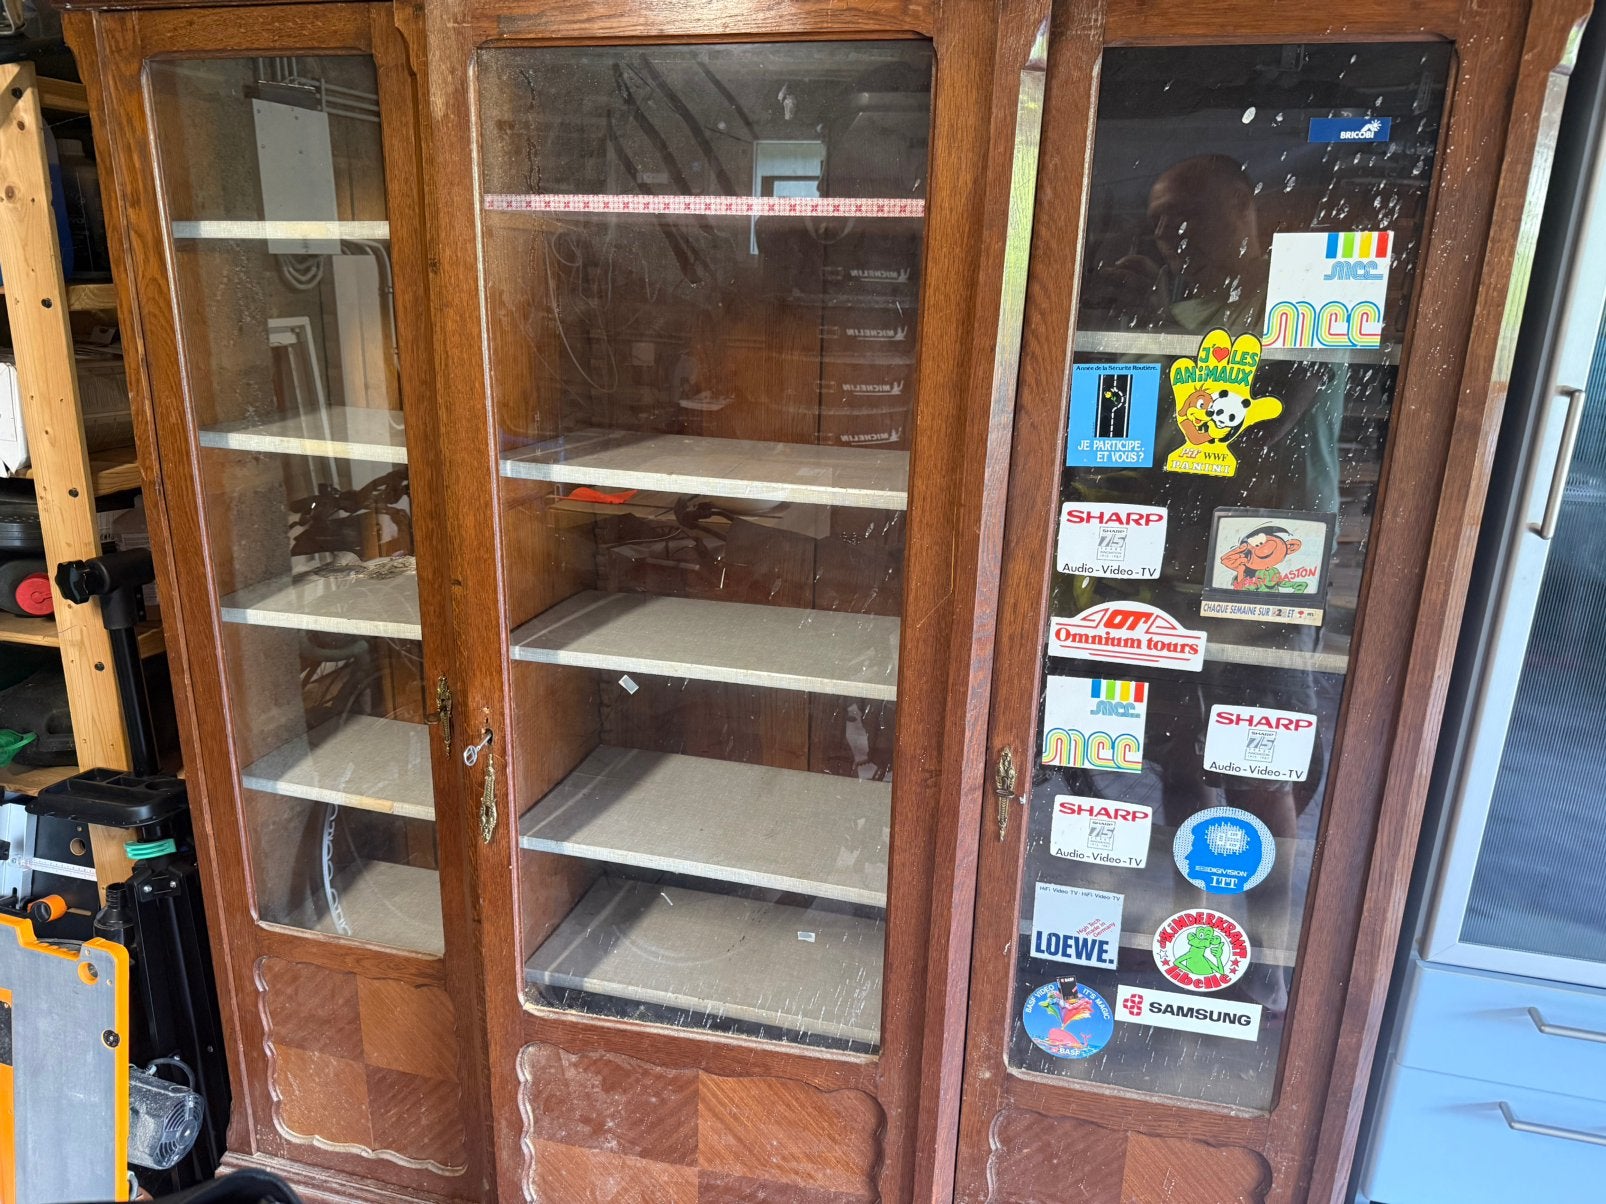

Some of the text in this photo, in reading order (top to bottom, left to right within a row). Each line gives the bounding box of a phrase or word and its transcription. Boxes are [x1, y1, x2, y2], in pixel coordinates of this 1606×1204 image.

[1340, 131, 1374, 139] BRICOBI
[1230, 350, 1258, 367] LES
[1077, 440, 1090, 451] JE
[1096, 451, 1109, 462] ET
[1203, 452, 1229, 461] WWF
[1171, 460, 1231, 474] PANINI
[1066, 510, 1164, 526] SHARP
[1203, 603, 1228, 614] CHAQUE
[1231, 605, 1257, 616] SEMAINE
[1258, 607, 1271, 617] SUR
[1055, 627, 1199, 655] Omnium tours
[1215, 712, 1313, 731] SHARP
[1058, 802, 1149, 822] SHARP
[1210, 875, 1238, 889] ITT
[1053, 887, 1069, 895] Video
[1092, 922, 1116, 938] Germany
[1164, 965, 1232, 989] libelle
[1025, 984, 1055, 1013] BASF VIDEO
[1082, 988, 1111, 1021] IT'S MAGIC
[1148, 1001, 1252, 1027] SAMSUNG
[1059, 1047, 1081, 1057] BASF
